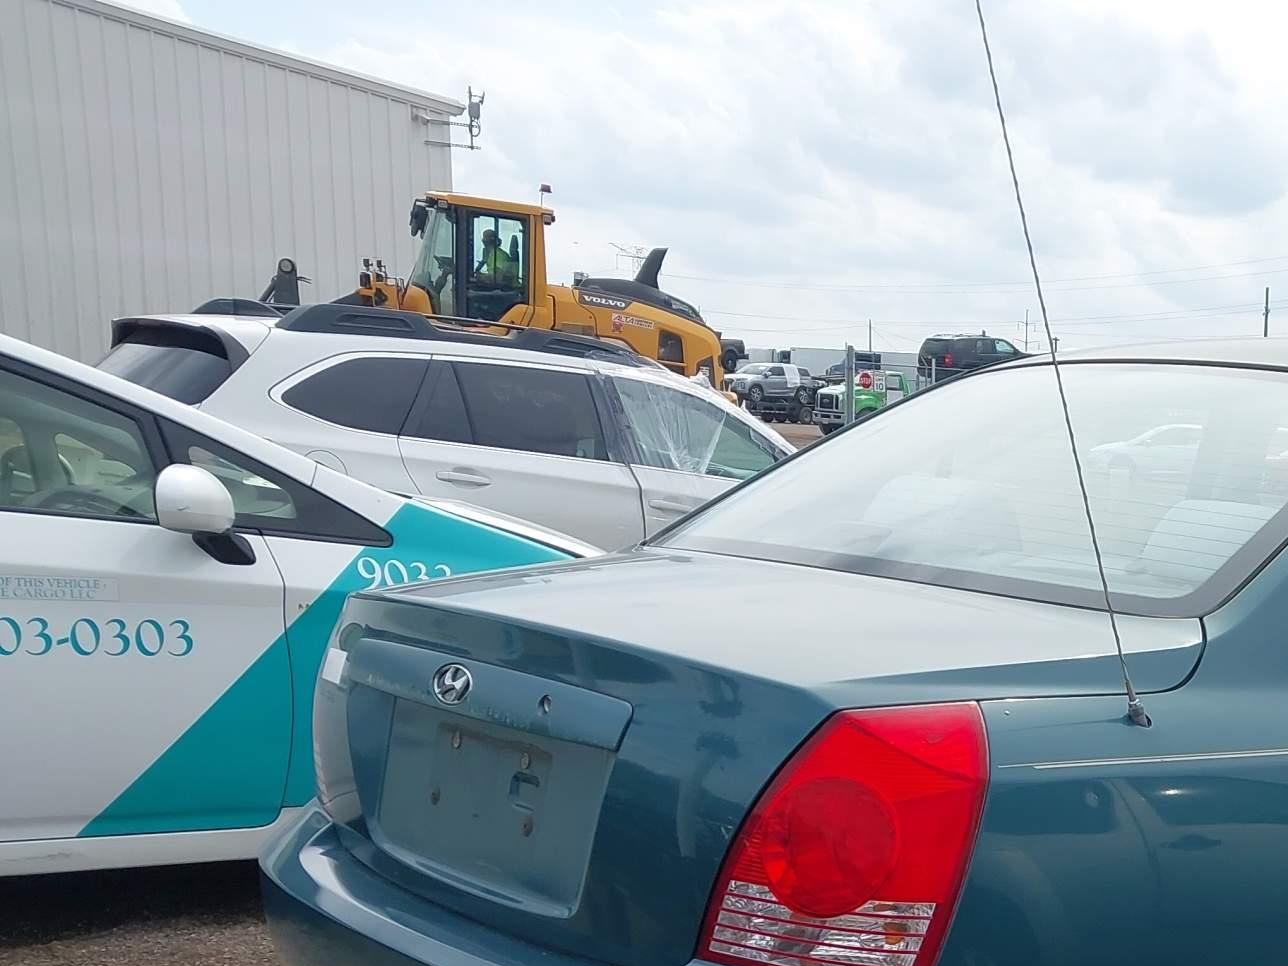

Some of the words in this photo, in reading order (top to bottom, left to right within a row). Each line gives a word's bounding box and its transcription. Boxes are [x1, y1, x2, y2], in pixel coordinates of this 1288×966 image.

[582, 295, 625, 307] VOLVO
[15, 577, 45, 588] THIS
[47, 578, 100, 589] VEHICLE
[13, 588, 66, 598] CARGO
[70, 590, 97, 599] LLC
